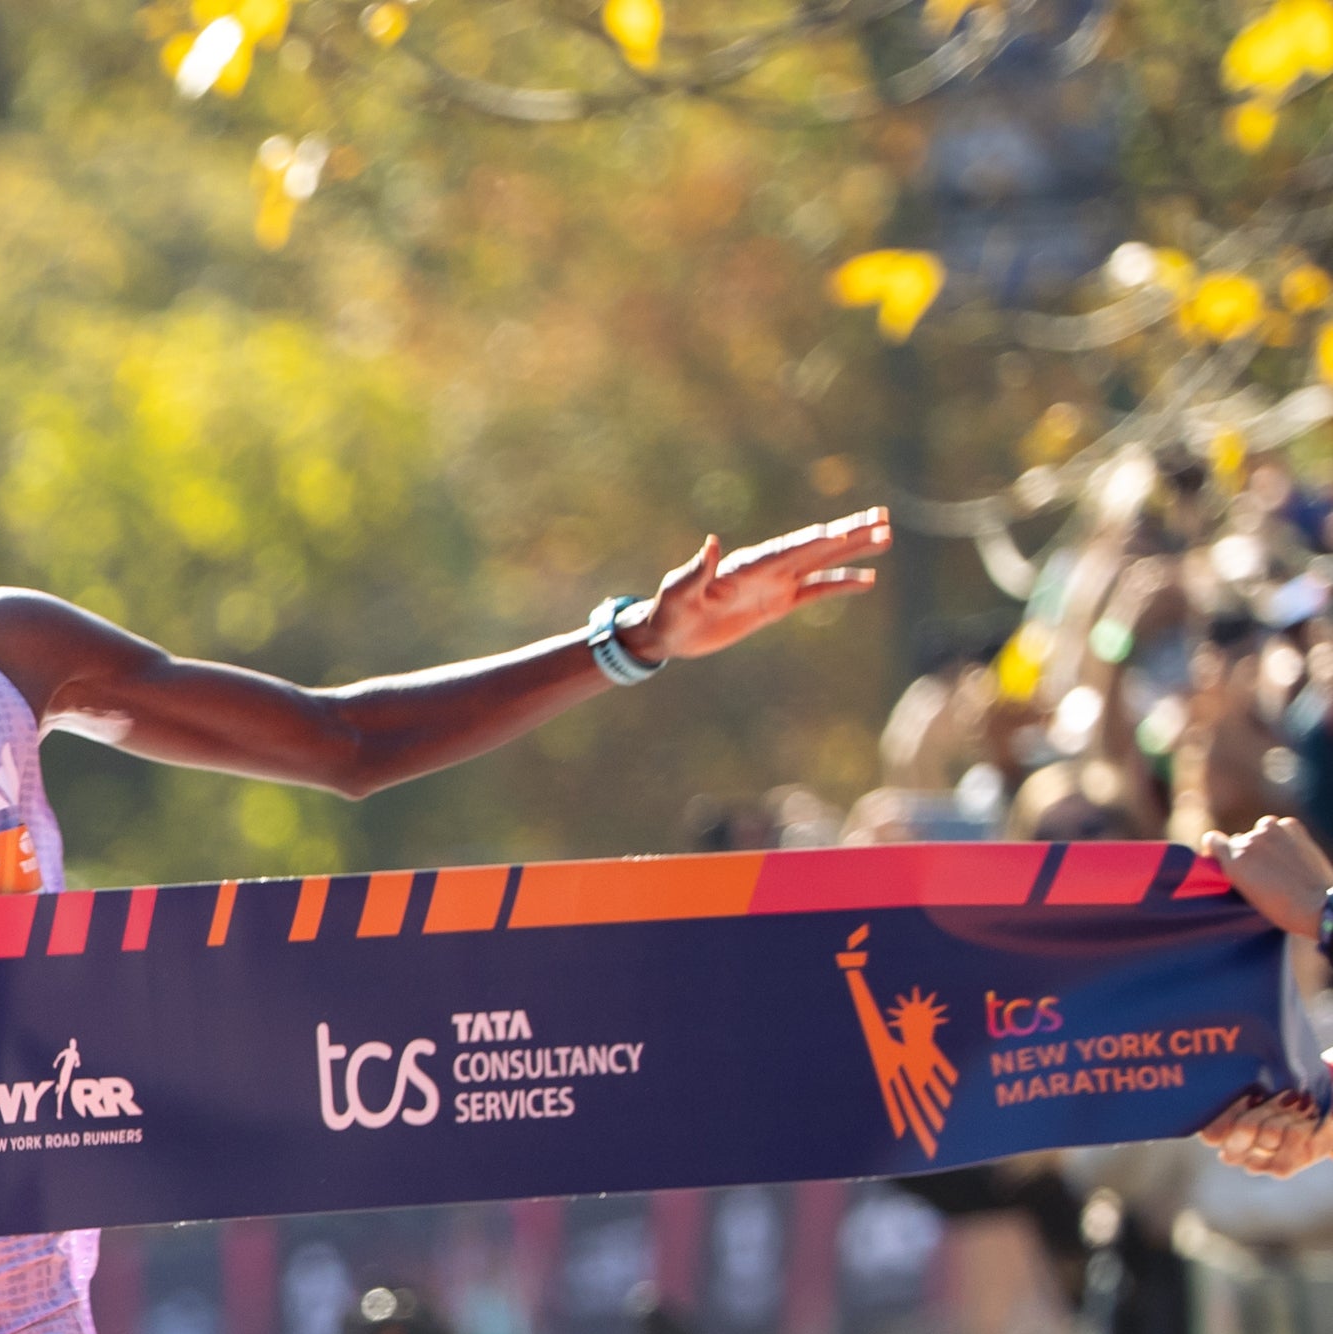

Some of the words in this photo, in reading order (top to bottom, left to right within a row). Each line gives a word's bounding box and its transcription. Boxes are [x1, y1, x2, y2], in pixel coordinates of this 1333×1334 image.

[452, 1009, 534, 1044] TATA
[986, 990, 1064, 1039] tcs
[452, 1041, 645, 1085] CONSULTANCY
[991, 1042, 1069, 1077] NEW
[1075, 1031, 1164, 1062] YORK
[1169, 1026, 1241, 1056] CITY
[316, 1021, 440, 1131] tcs
[996, 1064, 1184, 1107] MARATHON
[453, 1086, 576, 1125] SERVICES
[10, 1134, 42, 1151] YORK
[45, 1131, 80, 1149] ROAD
[83, 1127, 143, 1146] RUNNERS
